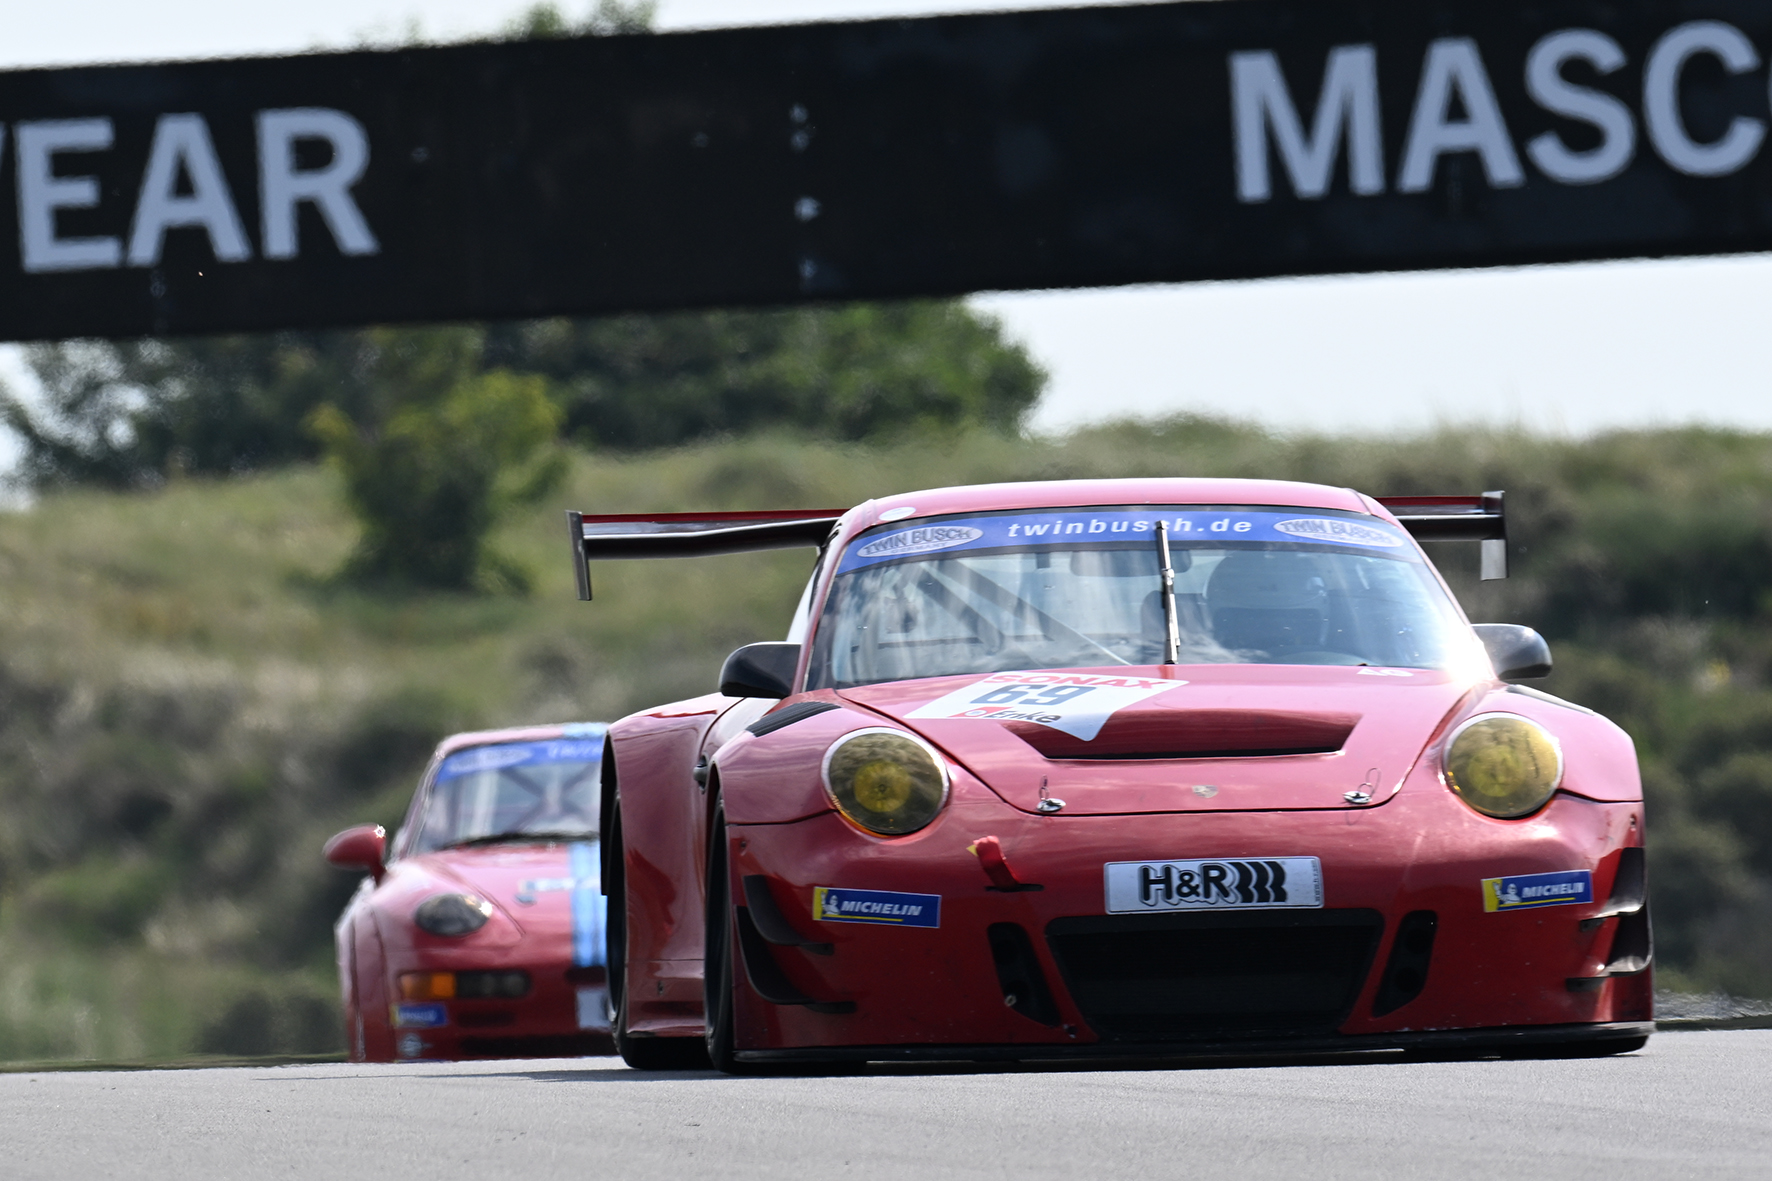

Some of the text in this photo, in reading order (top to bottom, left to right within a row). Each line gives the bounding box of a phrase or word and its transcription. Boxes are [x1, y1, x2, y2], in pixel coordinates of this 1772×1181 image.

[1228, 20, 1772, 202] MASC
[0, 106, 380, 274] EAR
[864, 527, 973, 554] TWIN BUSCH
[983, 675, 1168, 689] SONAX
[970, 684, 1098, 706] 69
[1140, 864, 1238, 904] H&R
[1522, 882, 1585, 898] MICHELIN
[840, 901, 922, 916] MICHELIN
